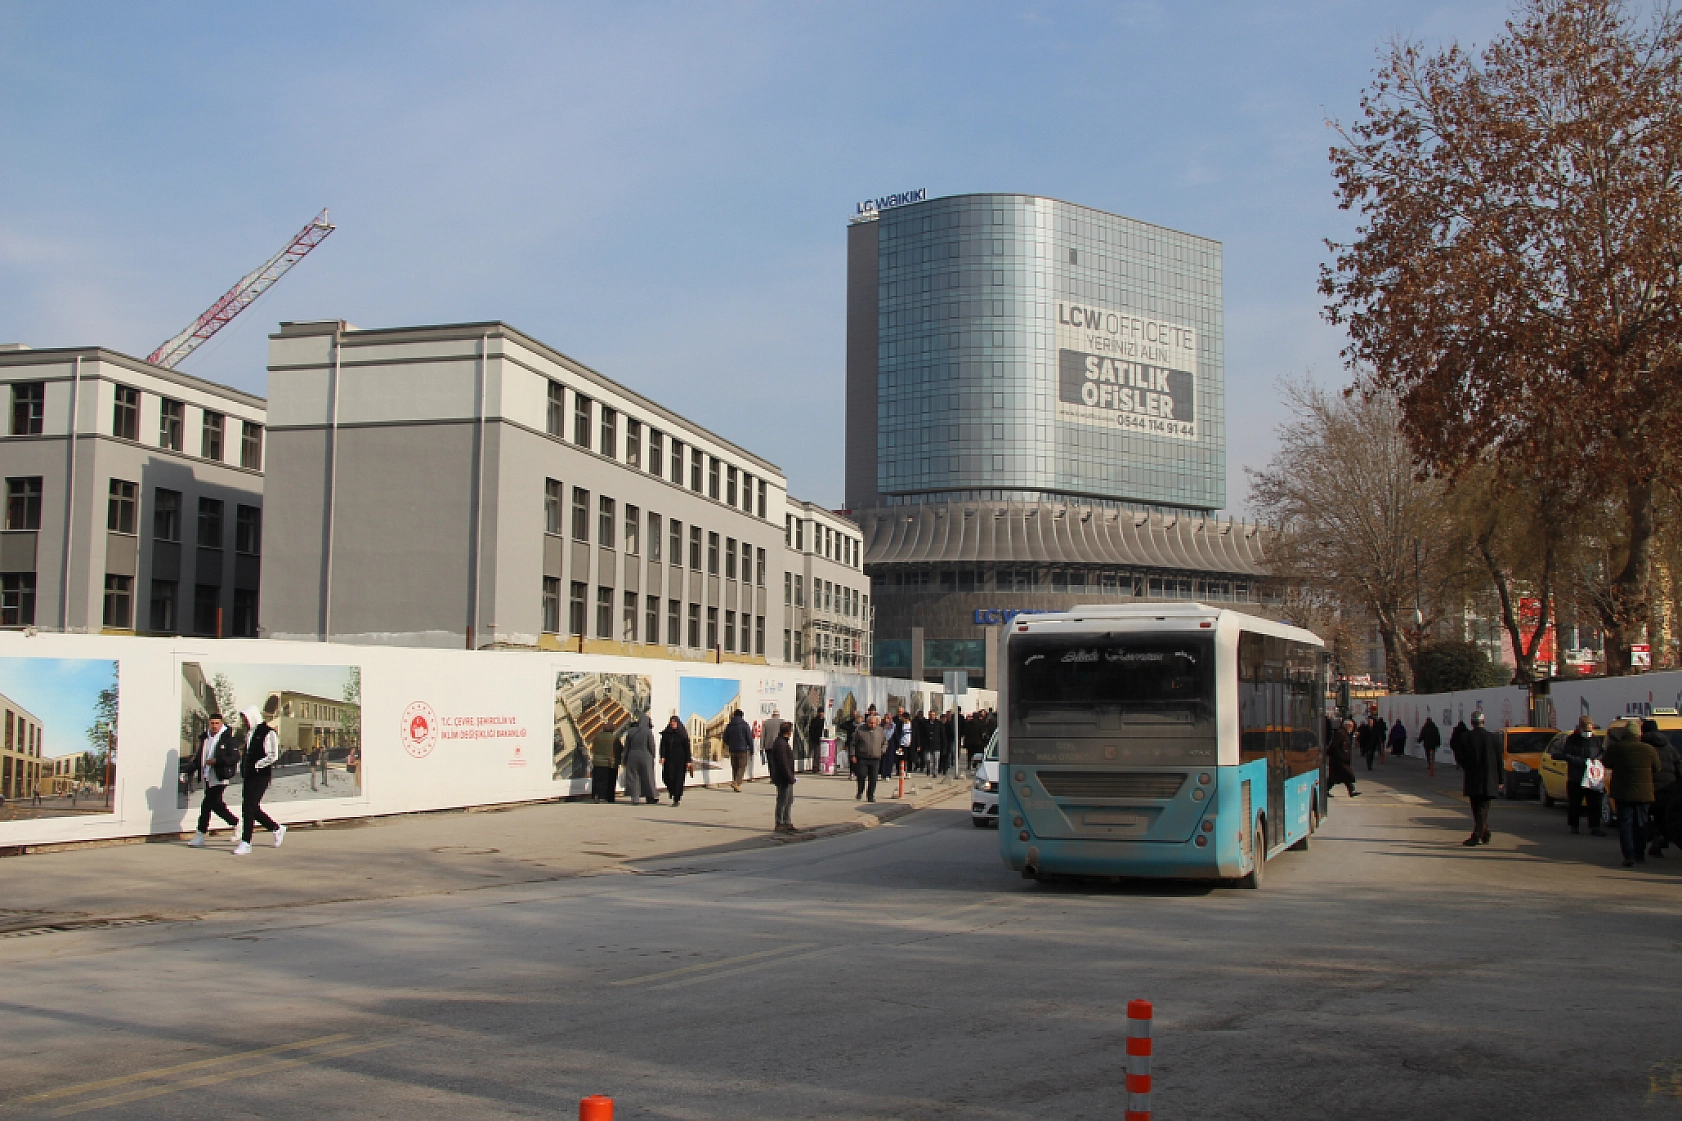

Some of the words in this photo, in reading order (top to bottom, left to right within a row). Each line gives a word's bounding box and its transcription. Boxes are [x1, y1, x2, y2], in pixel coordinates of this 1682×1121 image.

[856, 200, 875, 214] LC
[1058, 303, 1102, 331] LCW
[1084, 355, 1171, 393] SATILIK
[1081, 380, 1174, 419] OFİSLER
[1117, 414, 1145, 429] 0544
[1166, 422, 1178, 434] 91
[1180, 425, 1194, 437] 44
[974, 608, 998, 624] LC
